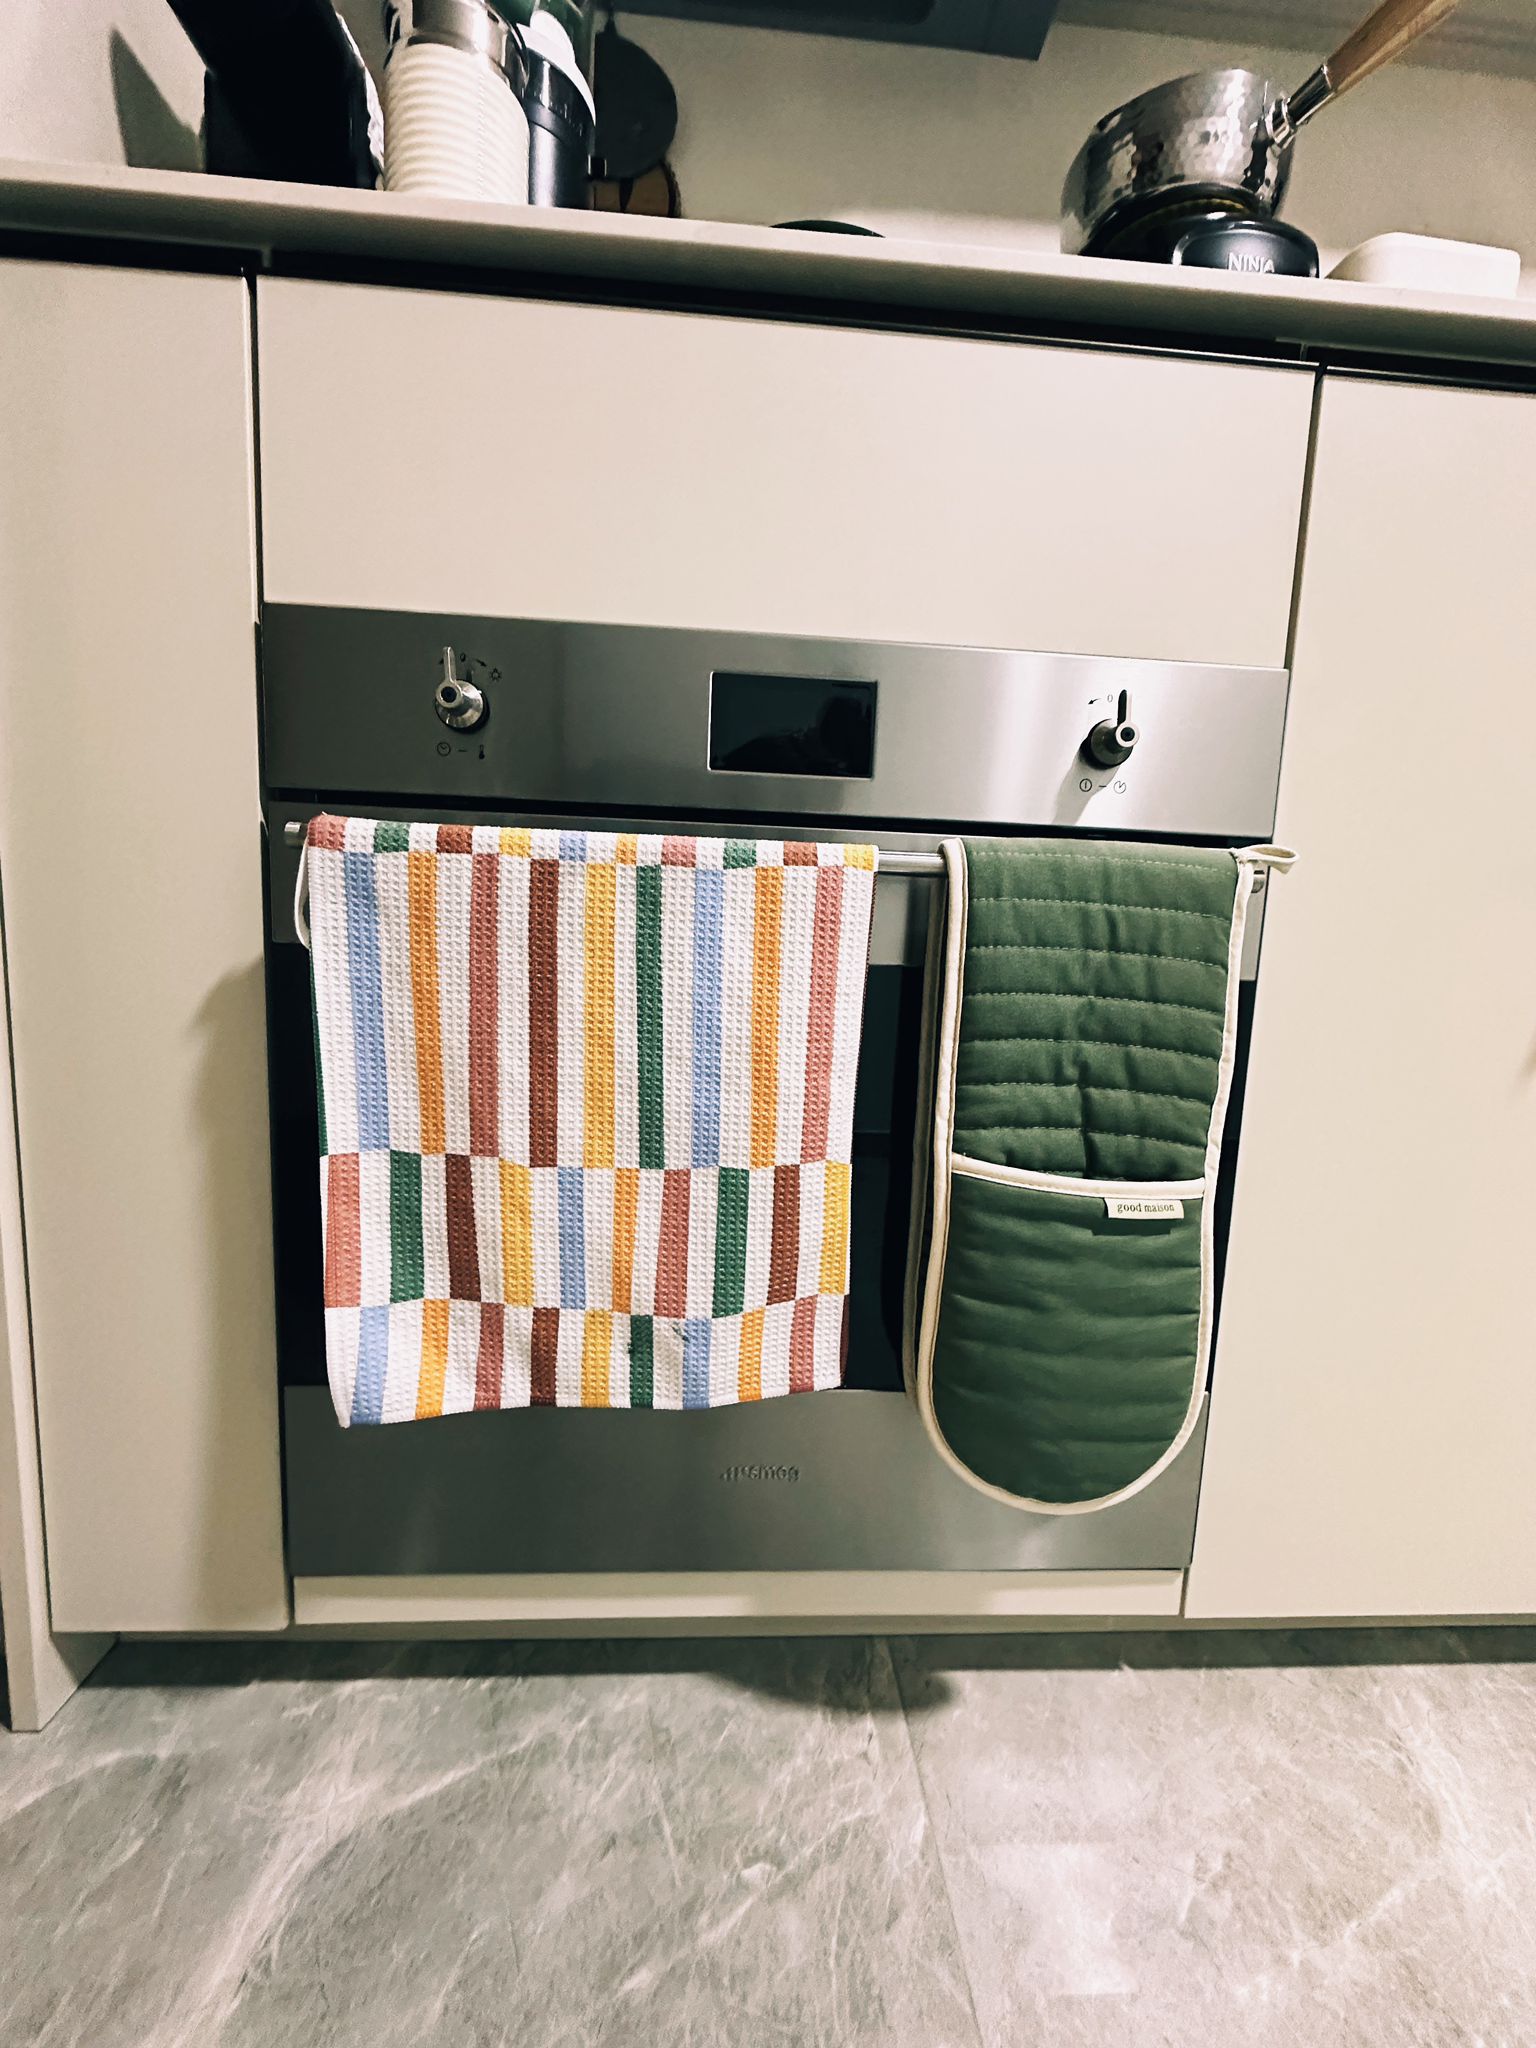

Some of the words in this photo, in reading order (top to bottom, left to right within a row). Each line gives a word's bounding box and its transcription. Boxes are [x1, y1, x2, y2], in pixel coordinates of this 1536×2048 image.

[1228, 252, 1275, 273] NINJA
[1117, 1203, 1142, 1214] good
[1144, 1203, 1175, 1213] maison
